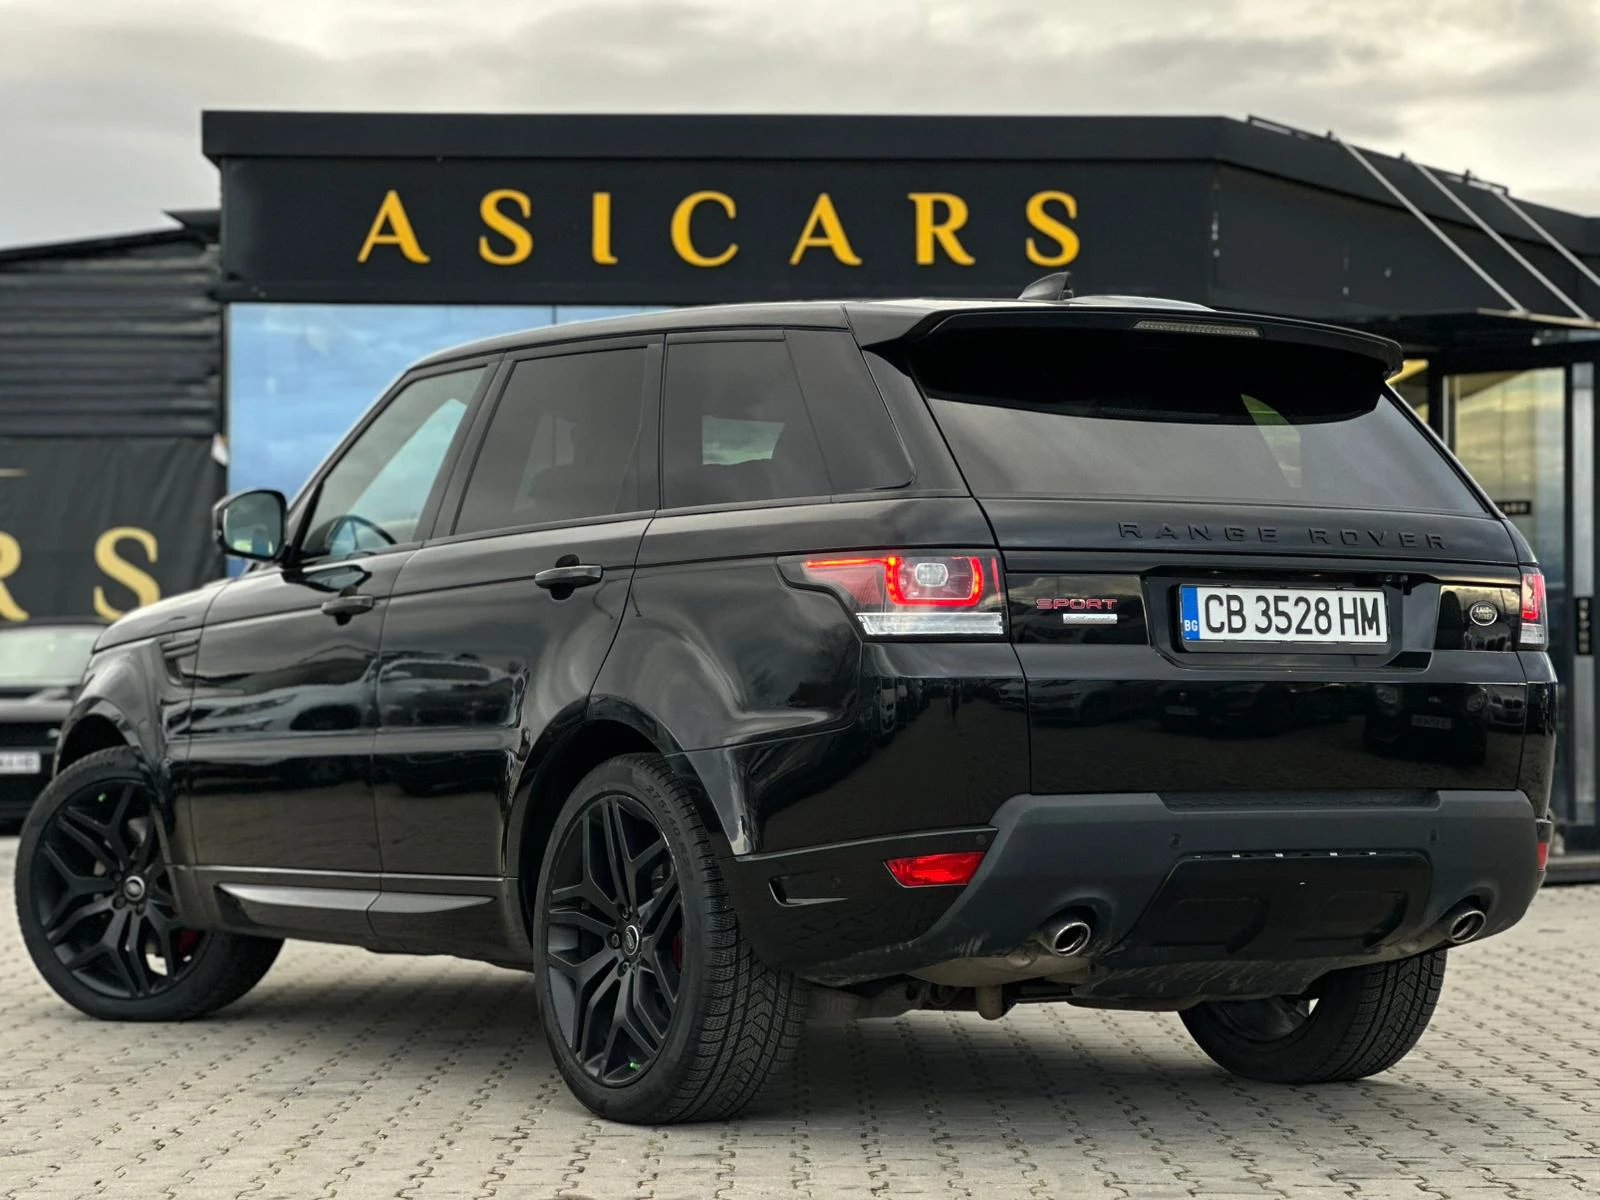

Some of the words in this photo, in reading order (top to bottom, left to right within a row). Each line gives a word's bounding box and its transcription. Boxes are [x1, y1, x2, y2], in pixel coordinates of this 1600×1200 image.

[357, 189, 1081, 267] ASICARS
[1118, 521, 1279, 543] RANGE
[1308, 527, 1447, 550] ROVER
[1036, 598, 1118, 610] SPORT
[1205, 594, 1247, 634] CB
[1255, 595, 1332, 635] 3528
[1338, 597, 1381, 636] HM
[1184, 619, 1198, 632] BG
